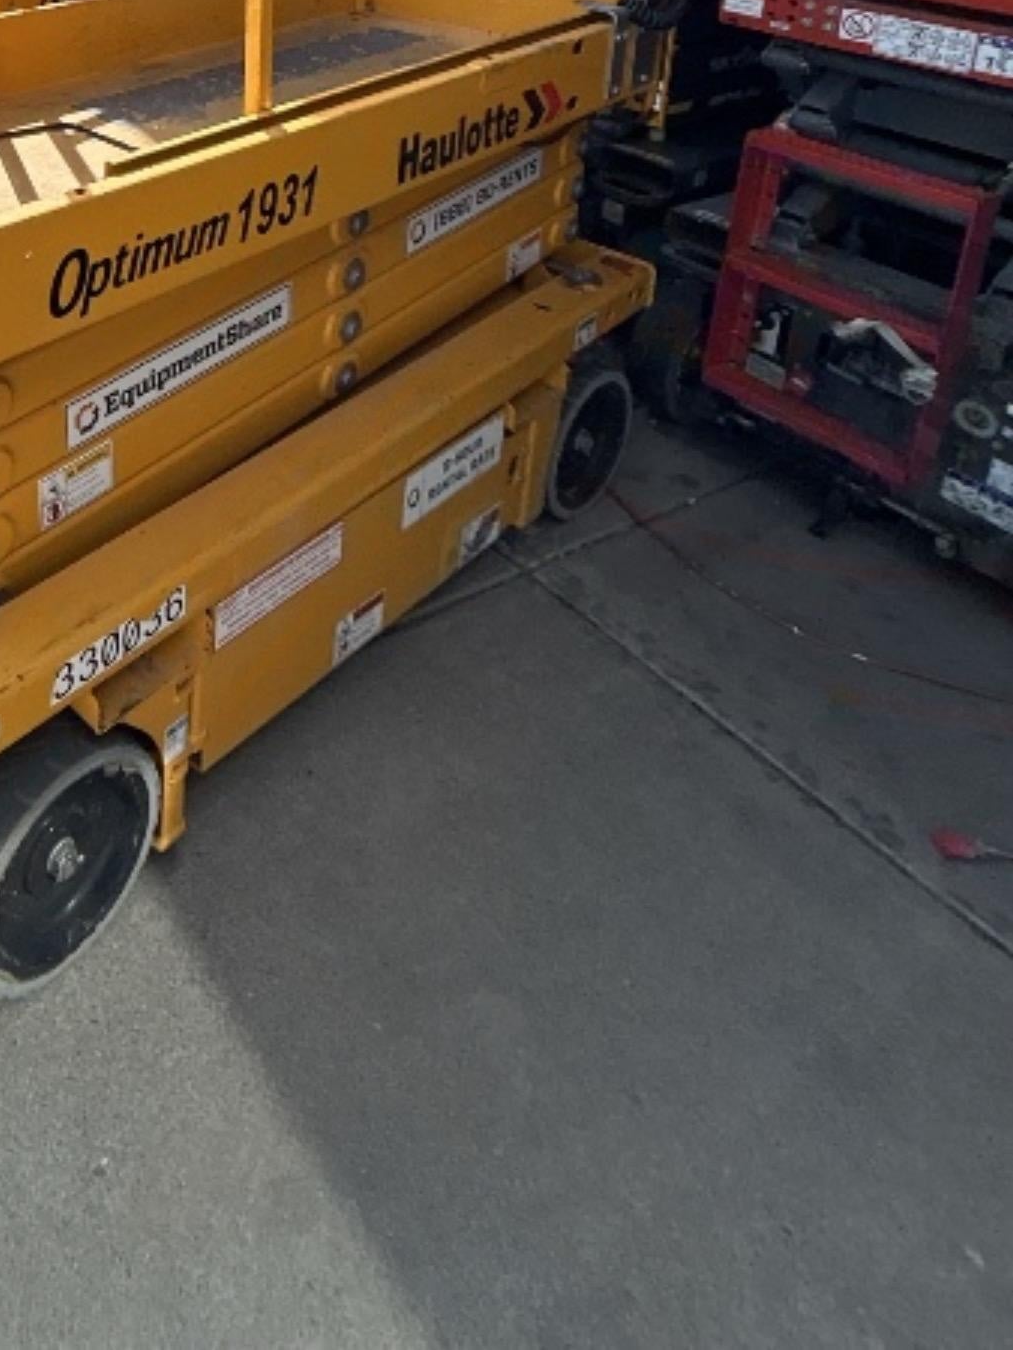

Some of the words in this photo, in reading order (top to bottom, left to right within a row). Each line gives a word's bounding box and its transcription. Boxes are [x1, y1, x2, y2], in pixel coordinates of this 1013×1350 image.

[398, 103, 519, 184] Haulotte
[48, 212, 231, 319] Optimum
[237, 165, 319, 243] 1931
[103, 302, 284, 418] EquipmentShare
[54, 586, 184, 700] 330036
